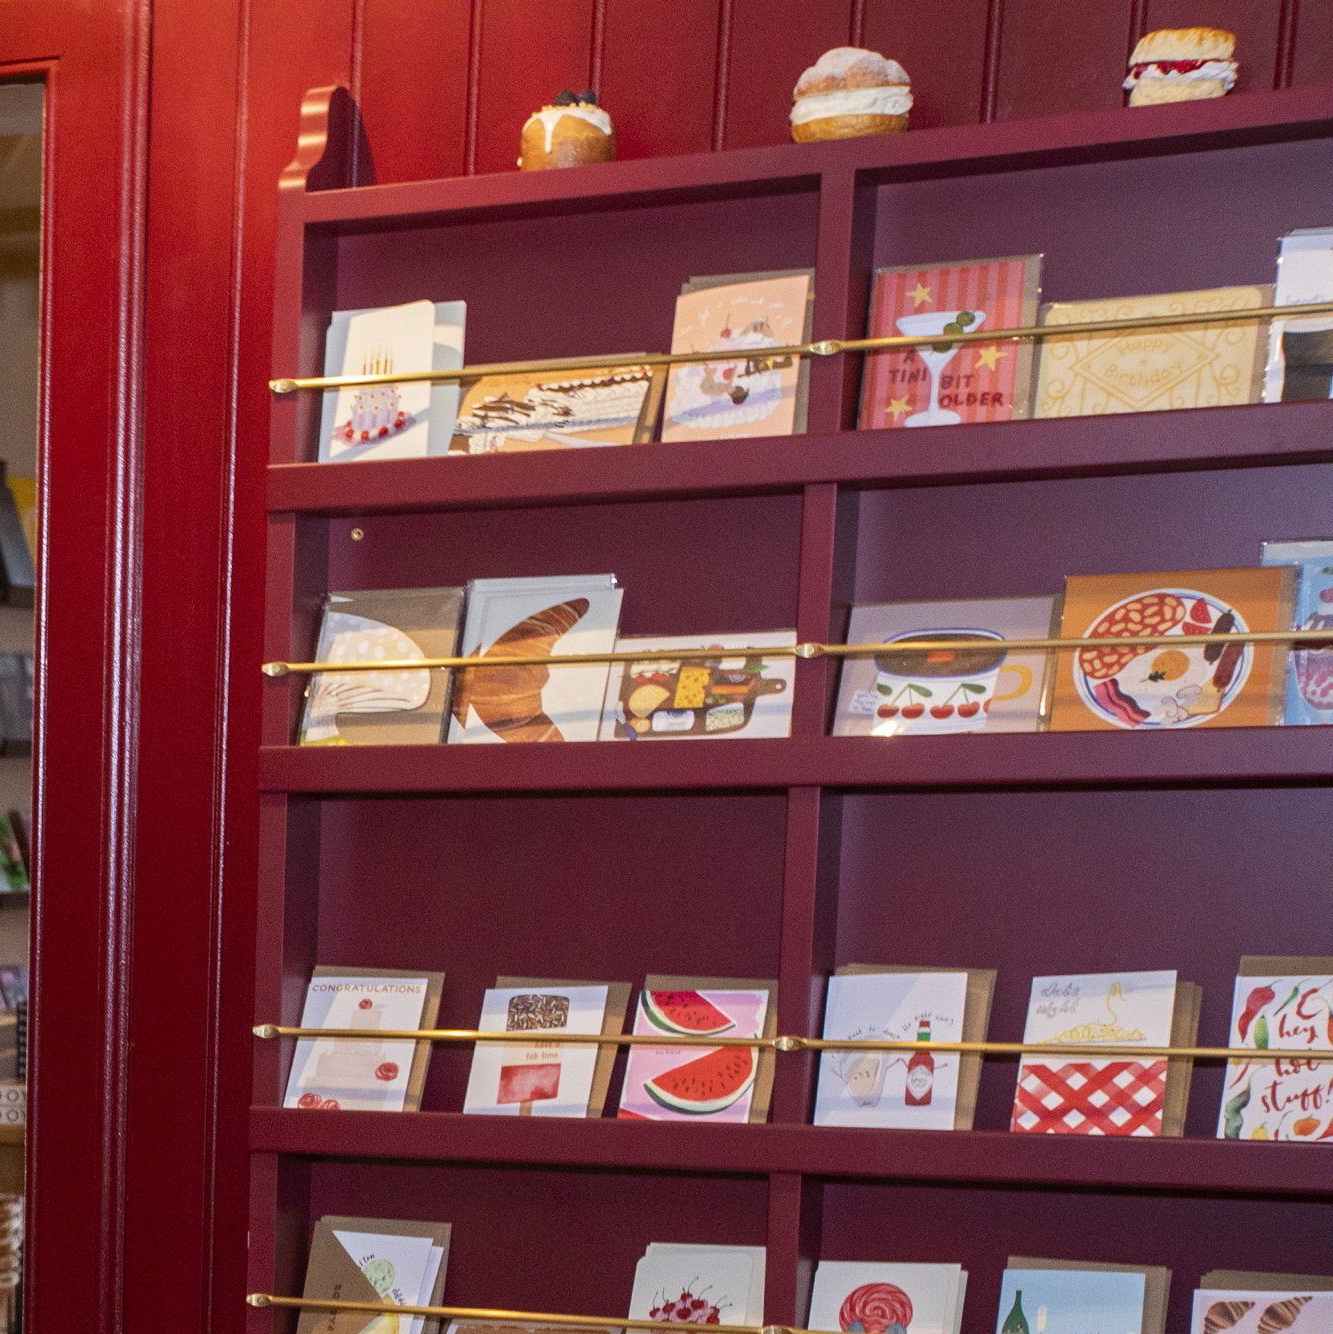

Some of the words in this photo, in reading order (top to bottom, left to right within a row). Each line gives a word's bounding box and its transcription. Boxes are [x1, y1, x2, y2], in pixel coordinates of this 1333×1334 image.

[904, 349, 915, 364] A
[889, 369, 930, 384] TINI
[939, 373, 975, 389] BIT
[1103, 362, 1184, 388] Birthday
[938, 392, 1004, 407] OLDER
[312, 983, 422, 995] CONGRATULATIONS
[1277, 1013, 1319, 1043] hey
[526, 1052, 542, 1061] fab
[544, 1051, 560, 1061] time
[1261, 1078, 1333, 1115] stuff!
